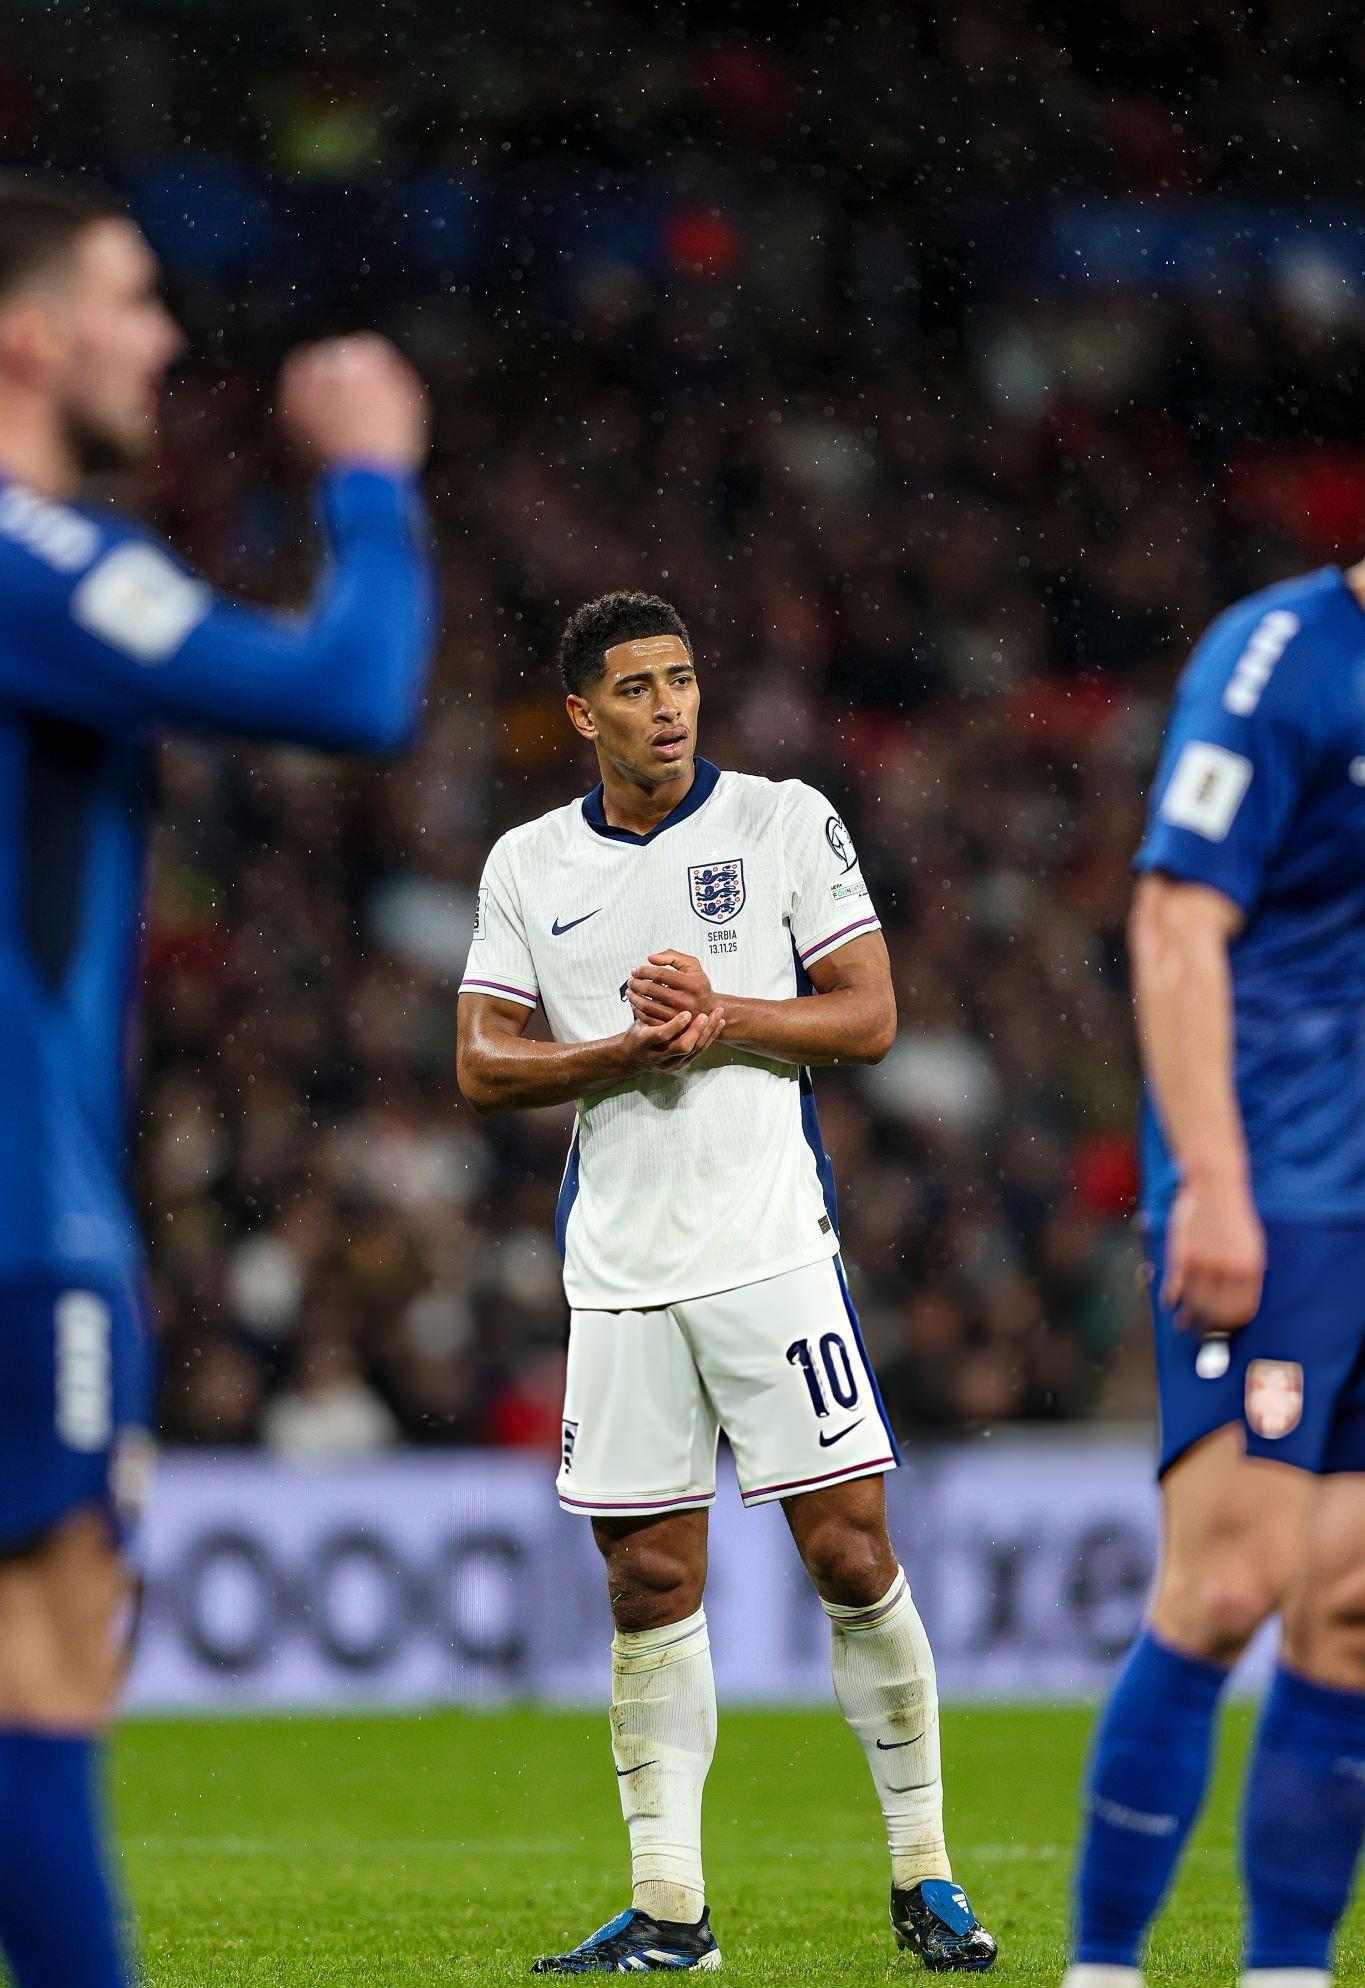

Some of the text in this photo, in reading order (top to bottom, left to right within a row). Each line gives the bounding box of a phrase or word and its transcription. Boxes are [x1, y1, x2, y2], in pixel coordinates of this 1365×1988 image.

[707, 929, 737, 942] SERBIA
[709, 942, 738, 954] 13.11.25
[786, 1332, 860, 1418] 10
